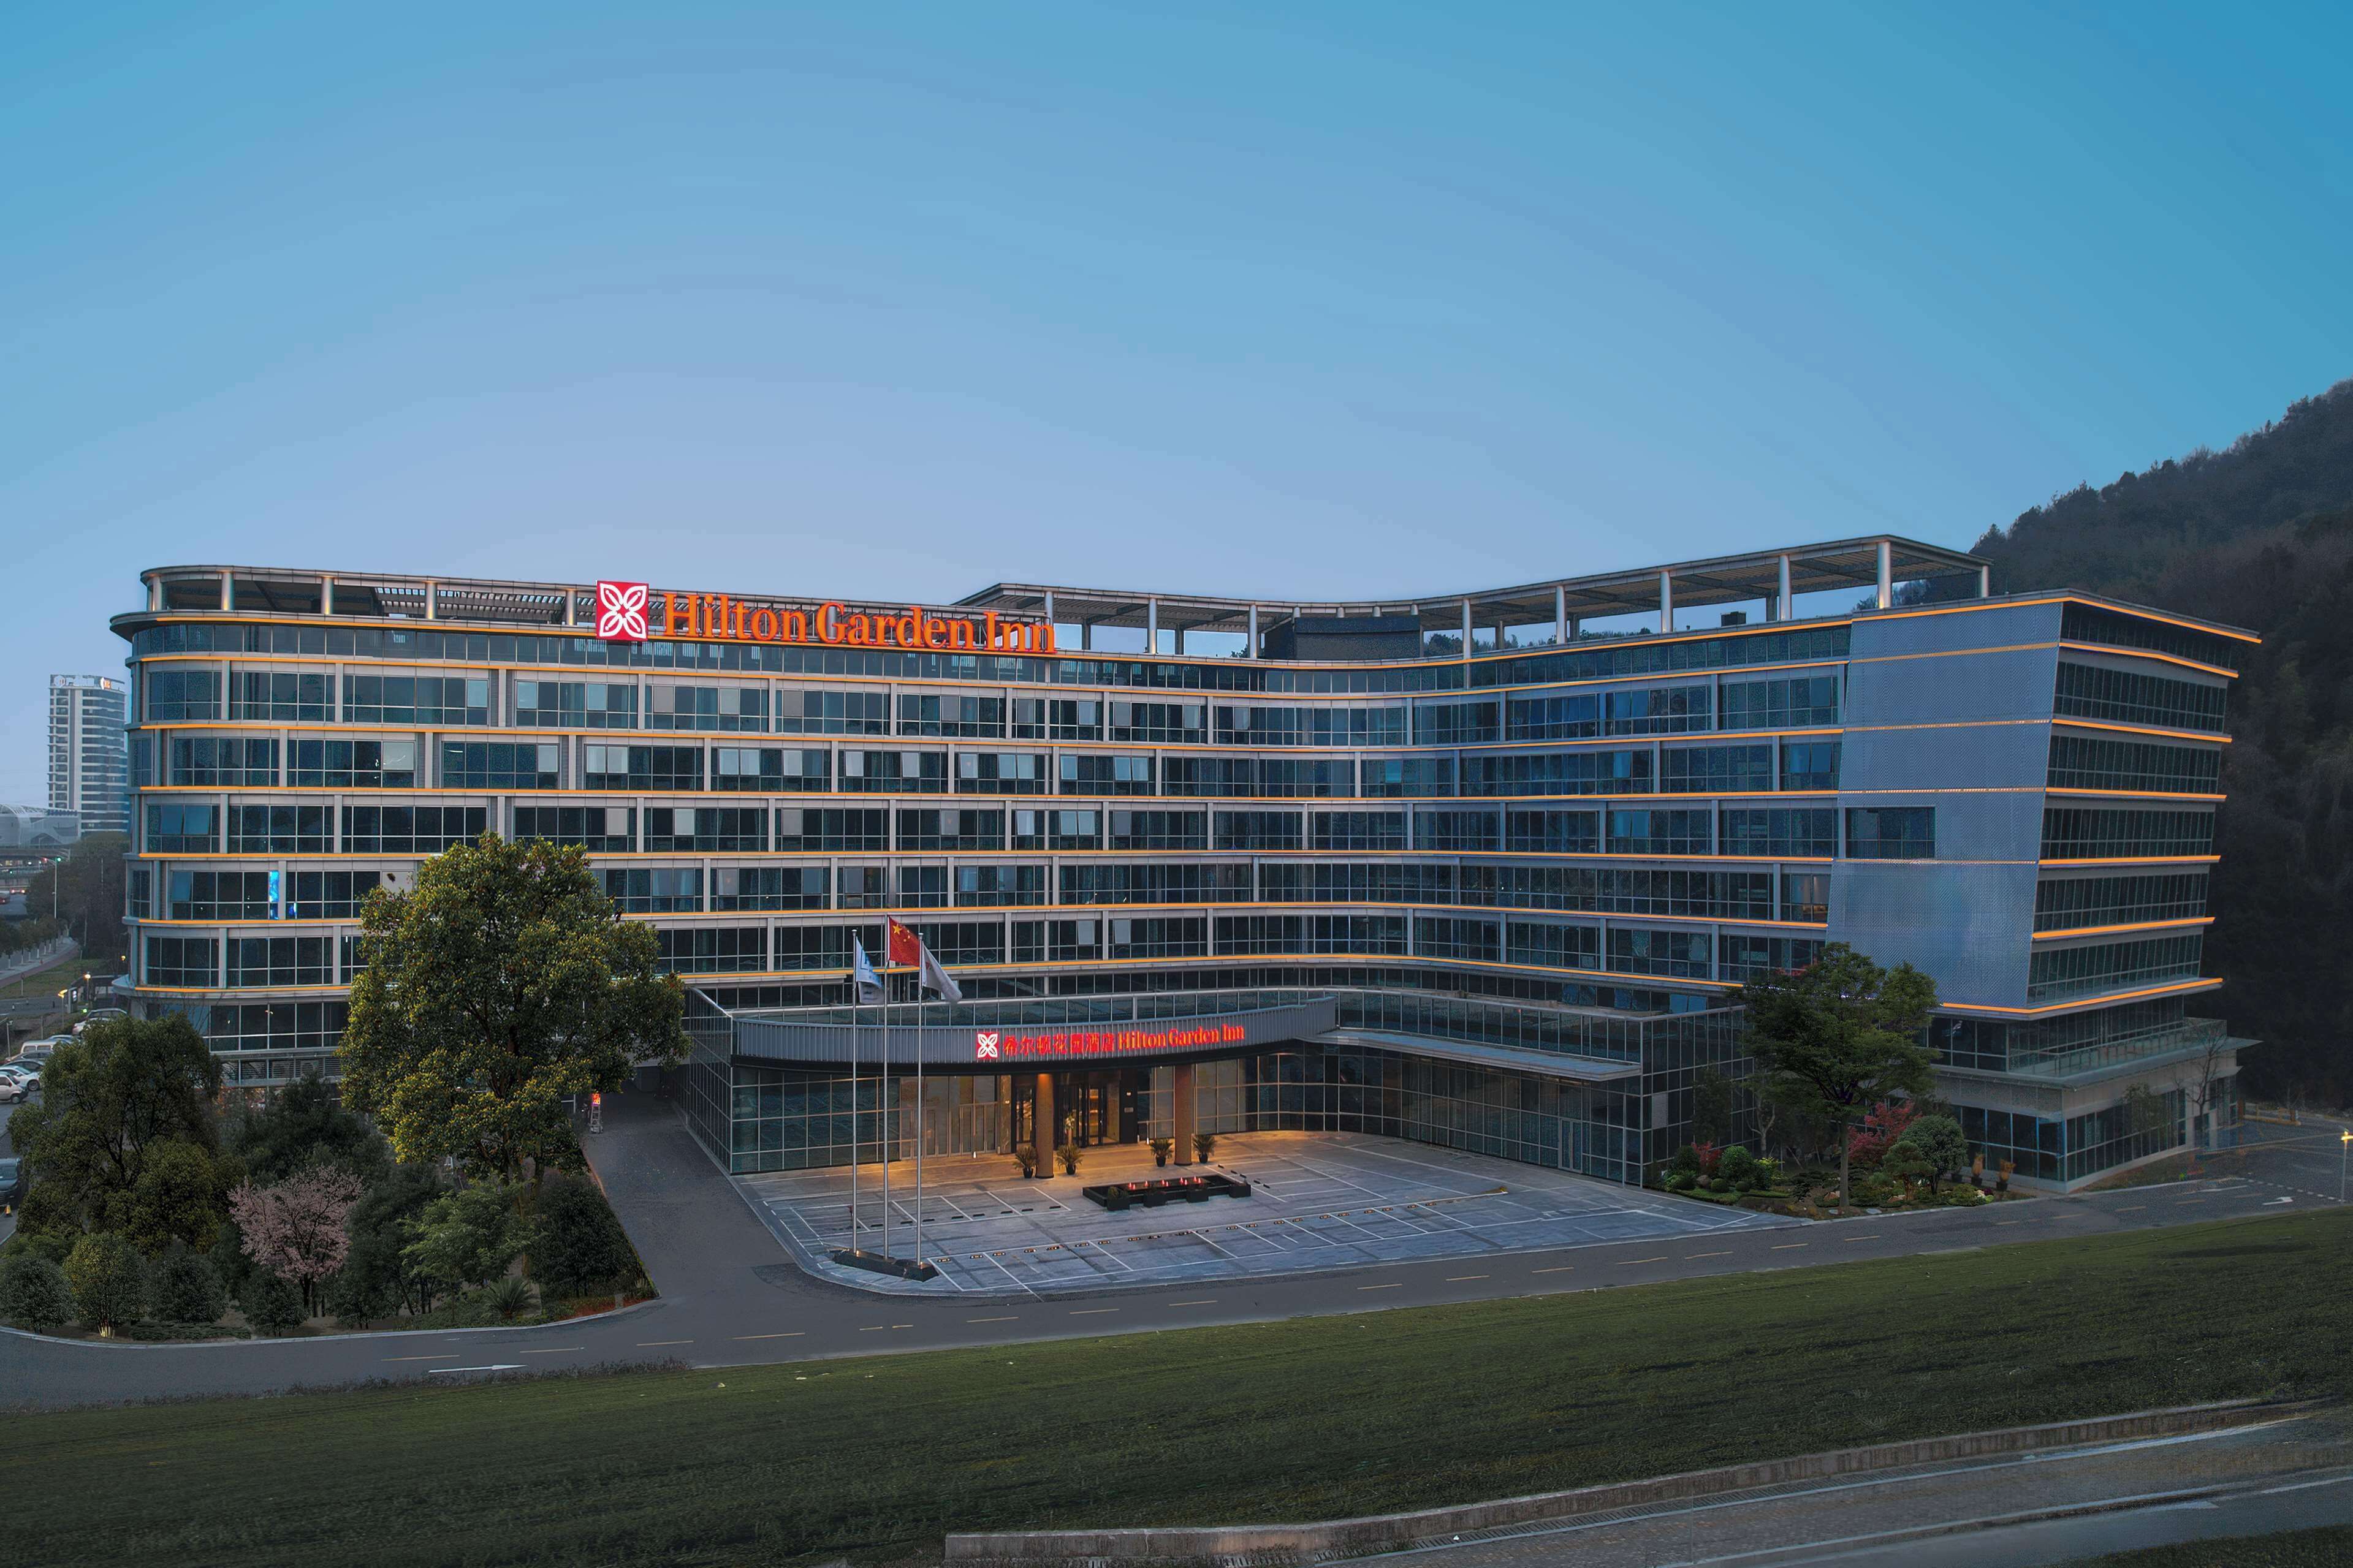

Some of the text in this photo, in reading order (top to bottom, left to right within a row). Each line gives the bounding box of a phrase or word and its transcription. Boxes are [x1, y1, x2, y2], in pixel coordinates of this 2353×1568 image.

[664, 593, 1055, 653] Hilton Garden Inn
[1004, 1033, 1114, 1056] 希尔顿花园酒店
[1117, 1023, 1245, 1051] Hilton Garden Inn
